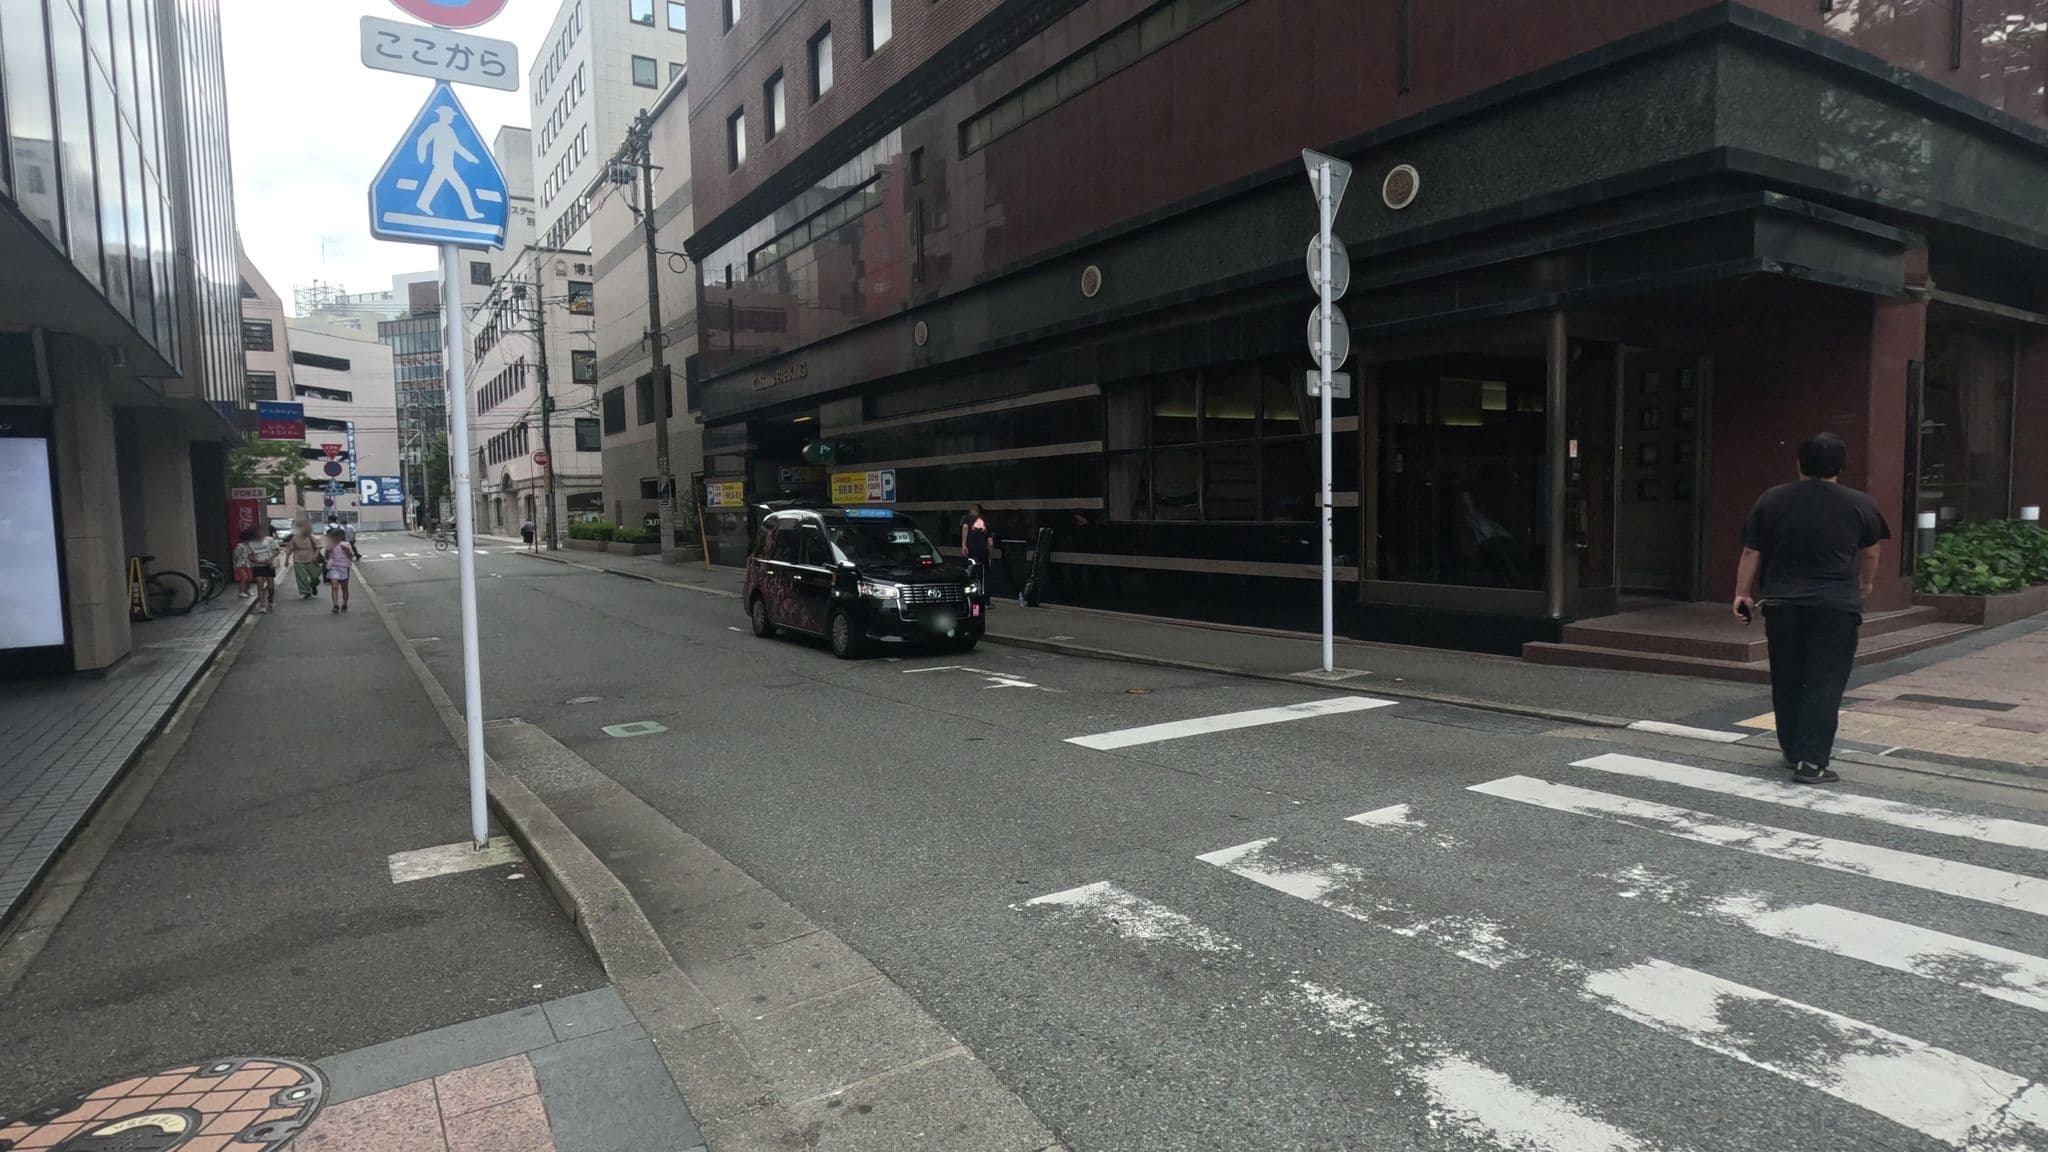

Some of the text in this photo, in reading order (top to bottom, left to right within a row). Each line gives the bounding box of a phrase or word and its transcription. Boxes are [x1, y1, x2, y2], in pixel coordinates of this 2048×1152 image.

[376, 31, 506, 77] ここから
[361, 480, 377, 504] P
[882, 473, 893, 500] P
